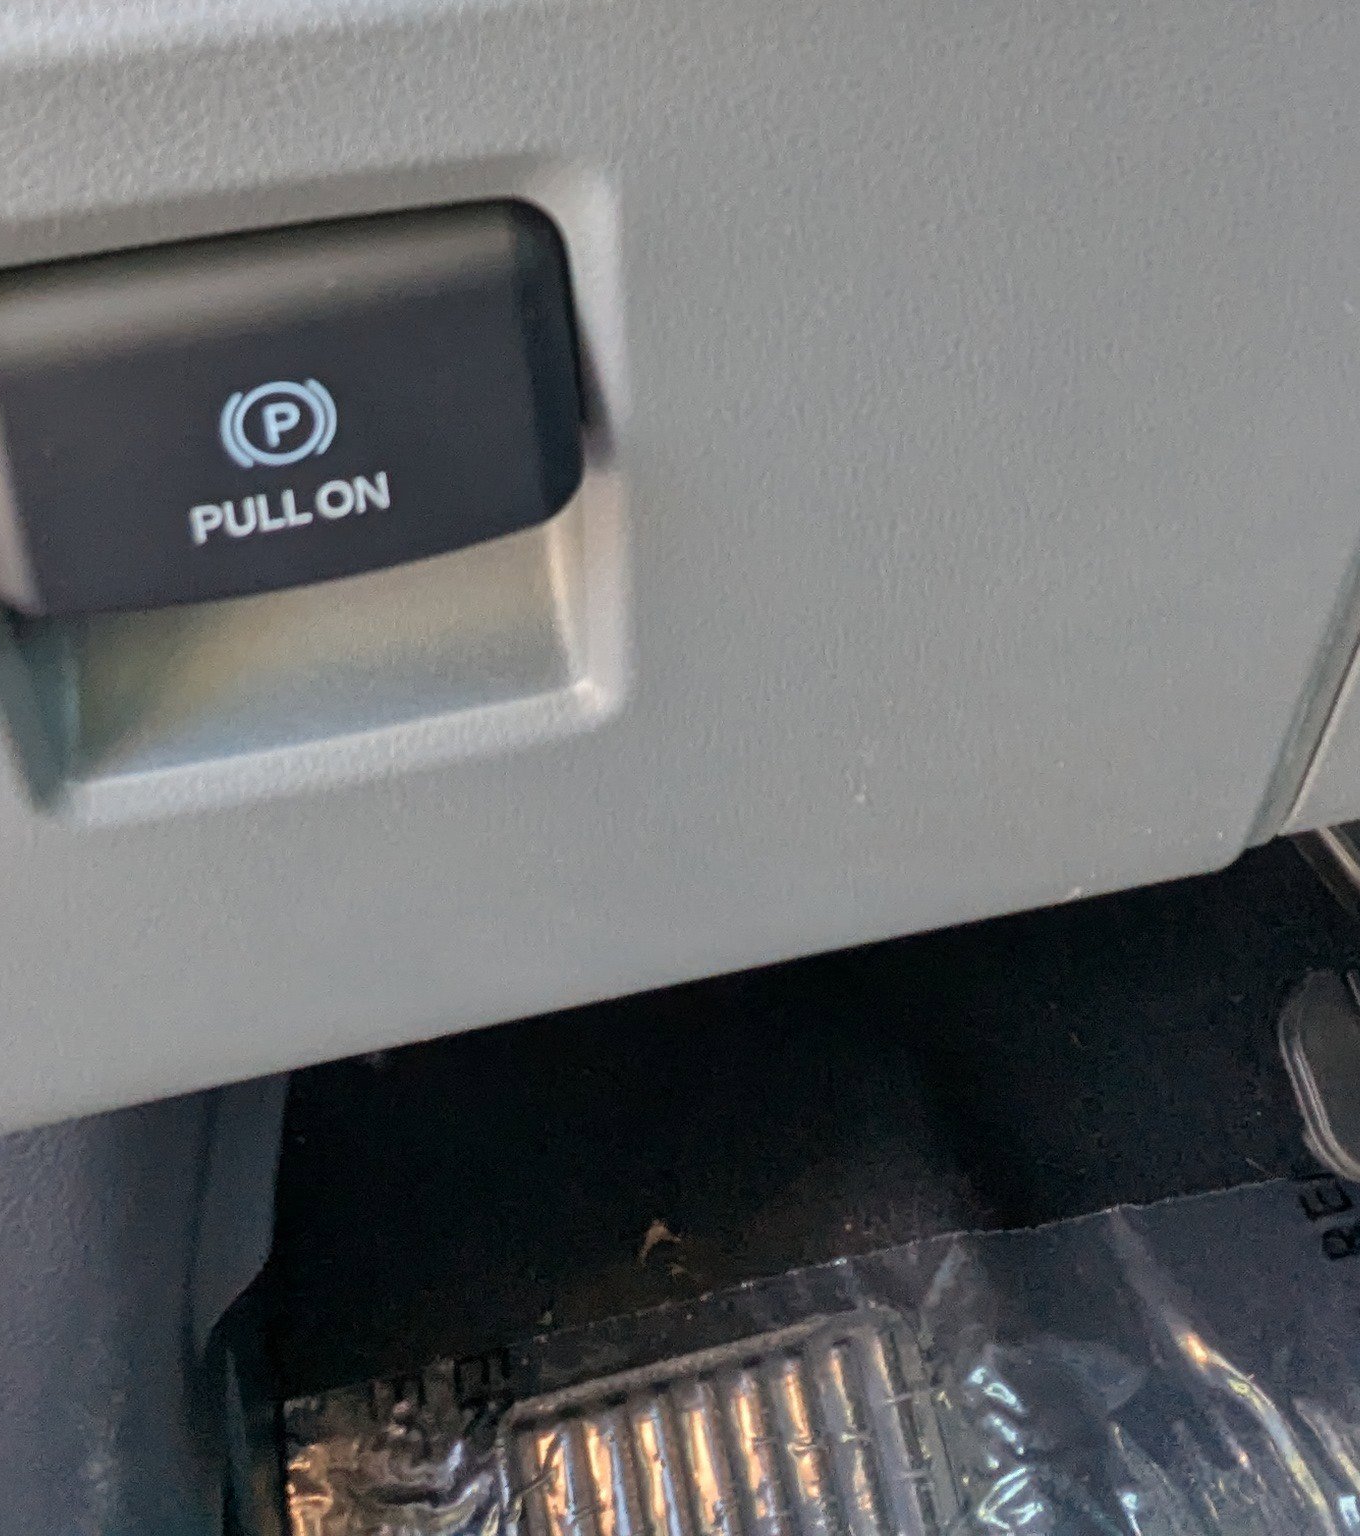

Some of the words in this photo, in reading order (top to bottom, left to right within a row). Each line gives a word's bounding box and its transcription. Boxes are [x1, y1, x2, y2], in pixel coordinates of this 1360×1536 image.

[261, 401, 301, 448] P
[190, 488, 314, 546] PULL
[315, 470, 392, 520] ON
